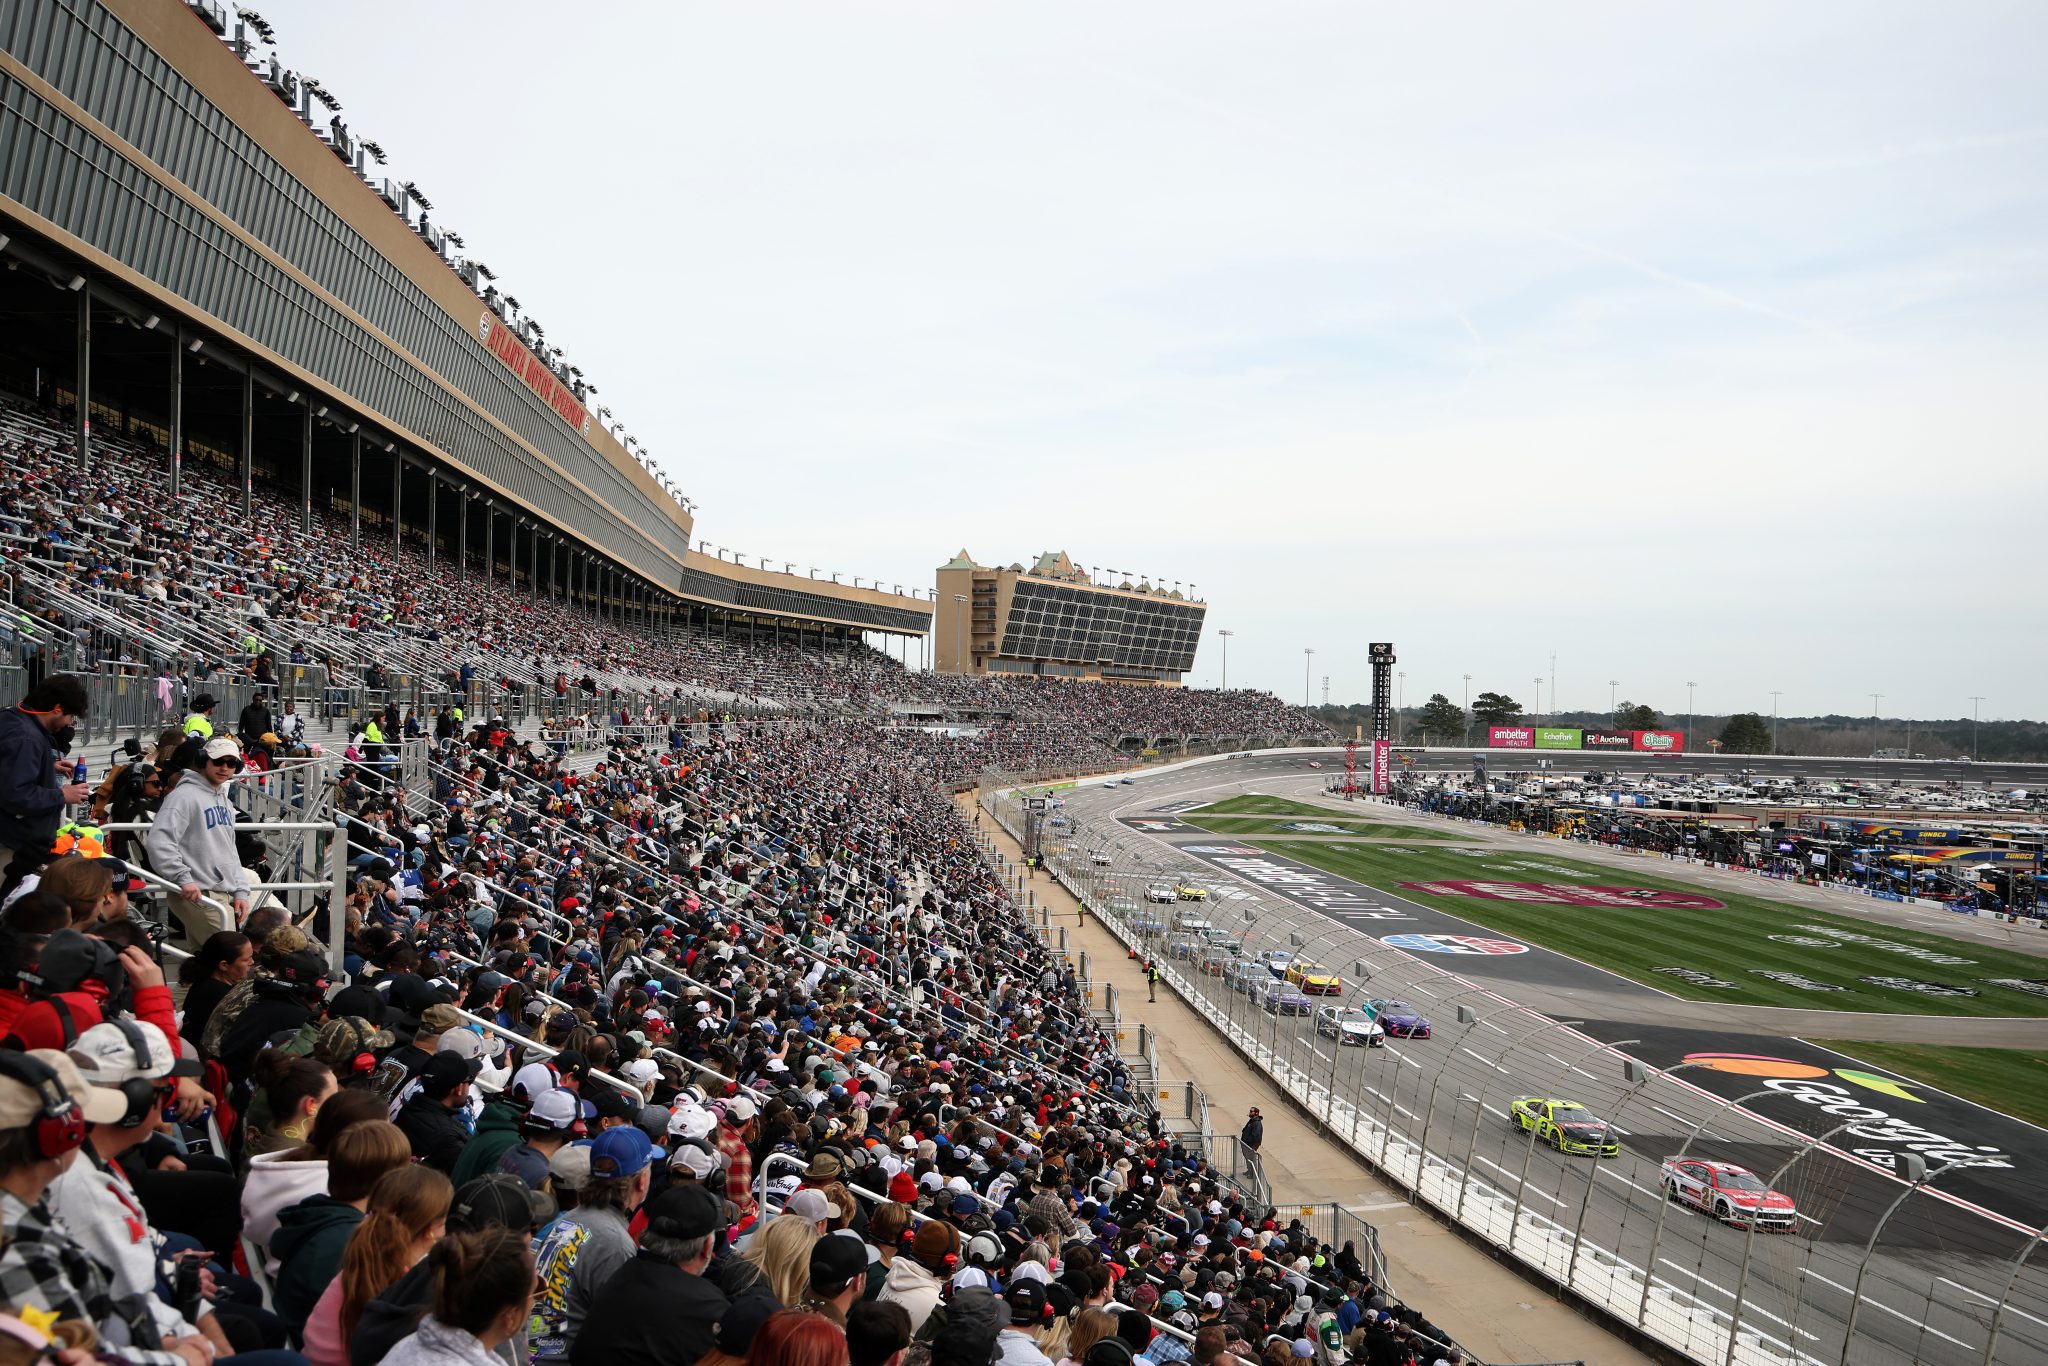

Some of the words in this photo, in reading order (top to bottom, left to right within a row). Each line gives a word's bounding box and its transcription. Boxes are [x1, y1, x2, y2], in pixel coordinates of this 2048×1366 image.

[488, 323, 526, 376] ATLANTA
[525, 358, 554, 401] MOTOR
[1495, 729, 1528, 739] ambetter
[1543, 732, 1573, 741] EchoPark
[1377, 745, 1388, 790] ambetter
[204, 805, 233, 829] DUK
[2004, 852, 2035, 860] SUNOCO
[1274, 885, 1419, 921] HEALTH
[1763, 1079, 2015, 1168] Georgia
[776, 1179, 794, 1192] Only
[535, 1337, 565, 1347] Hendrick
